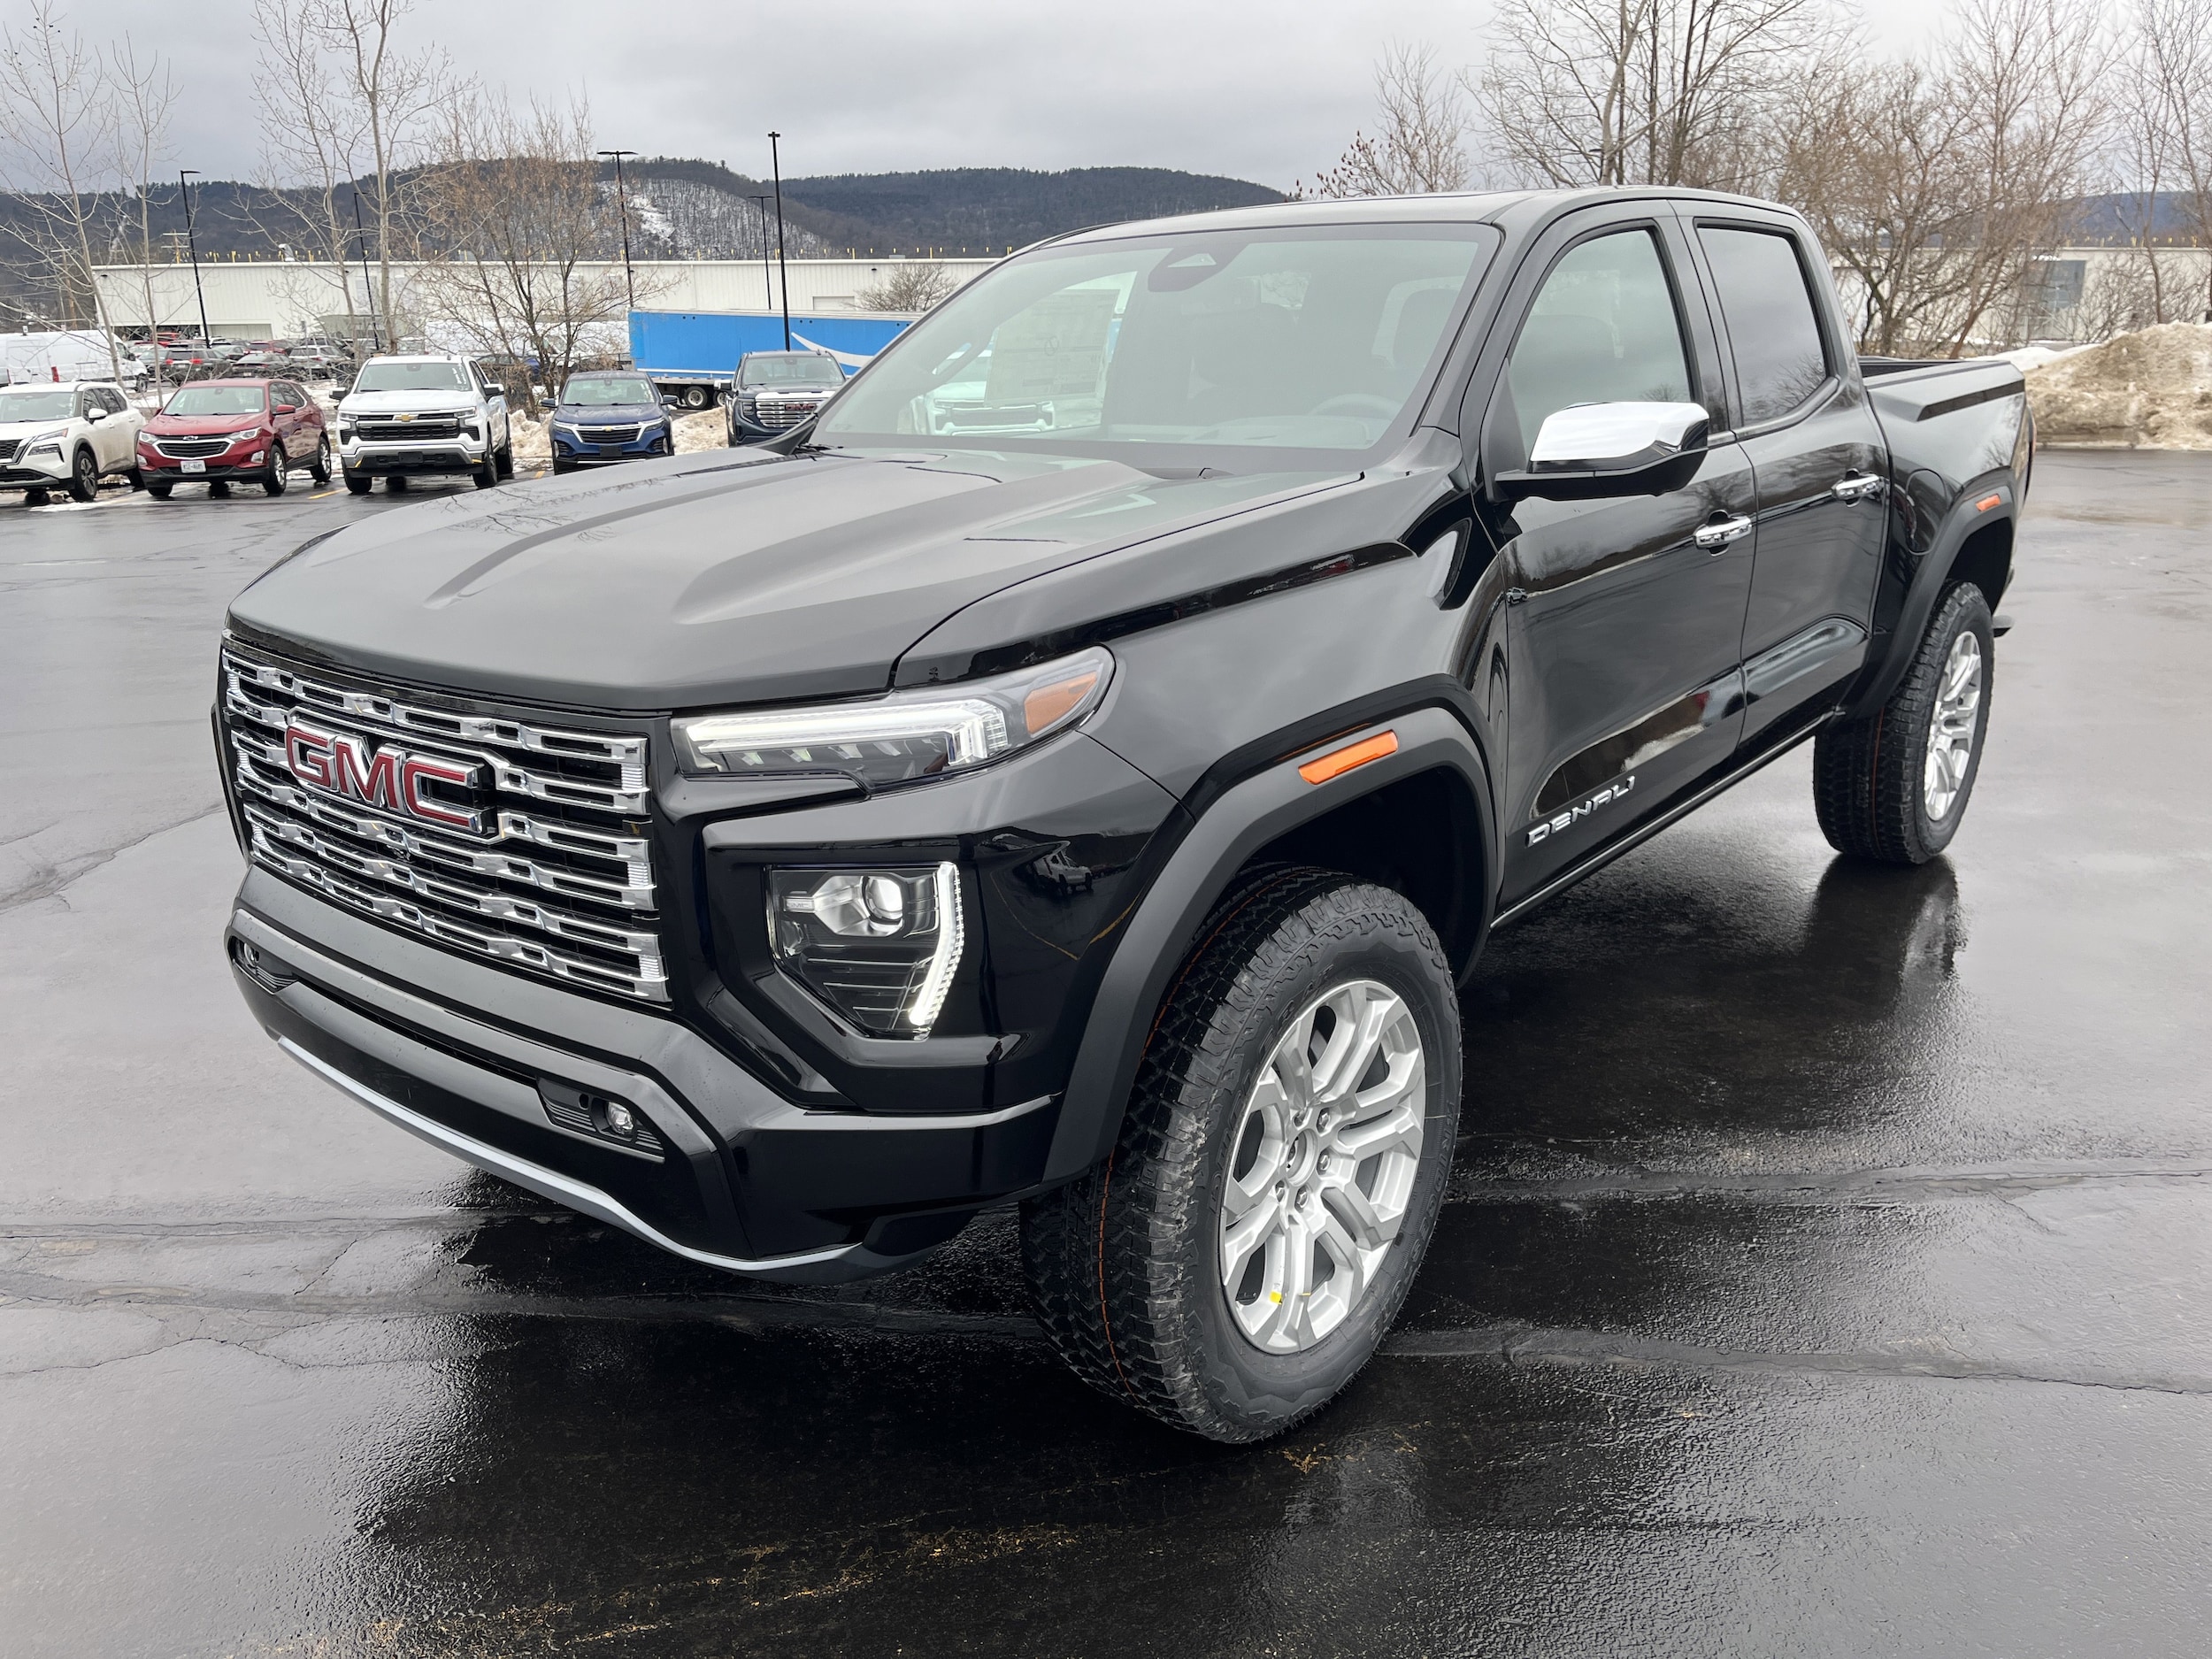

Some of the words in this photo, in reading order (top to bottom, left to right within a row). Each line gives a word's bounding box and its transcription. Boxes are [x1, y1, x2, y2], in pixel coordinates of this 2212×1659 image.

[286, 721, 484, 834] GMC
[1525, 775, 1636, 848] DENALI
[1369, 1100, 1455, 1343] BRIDGESTONE
